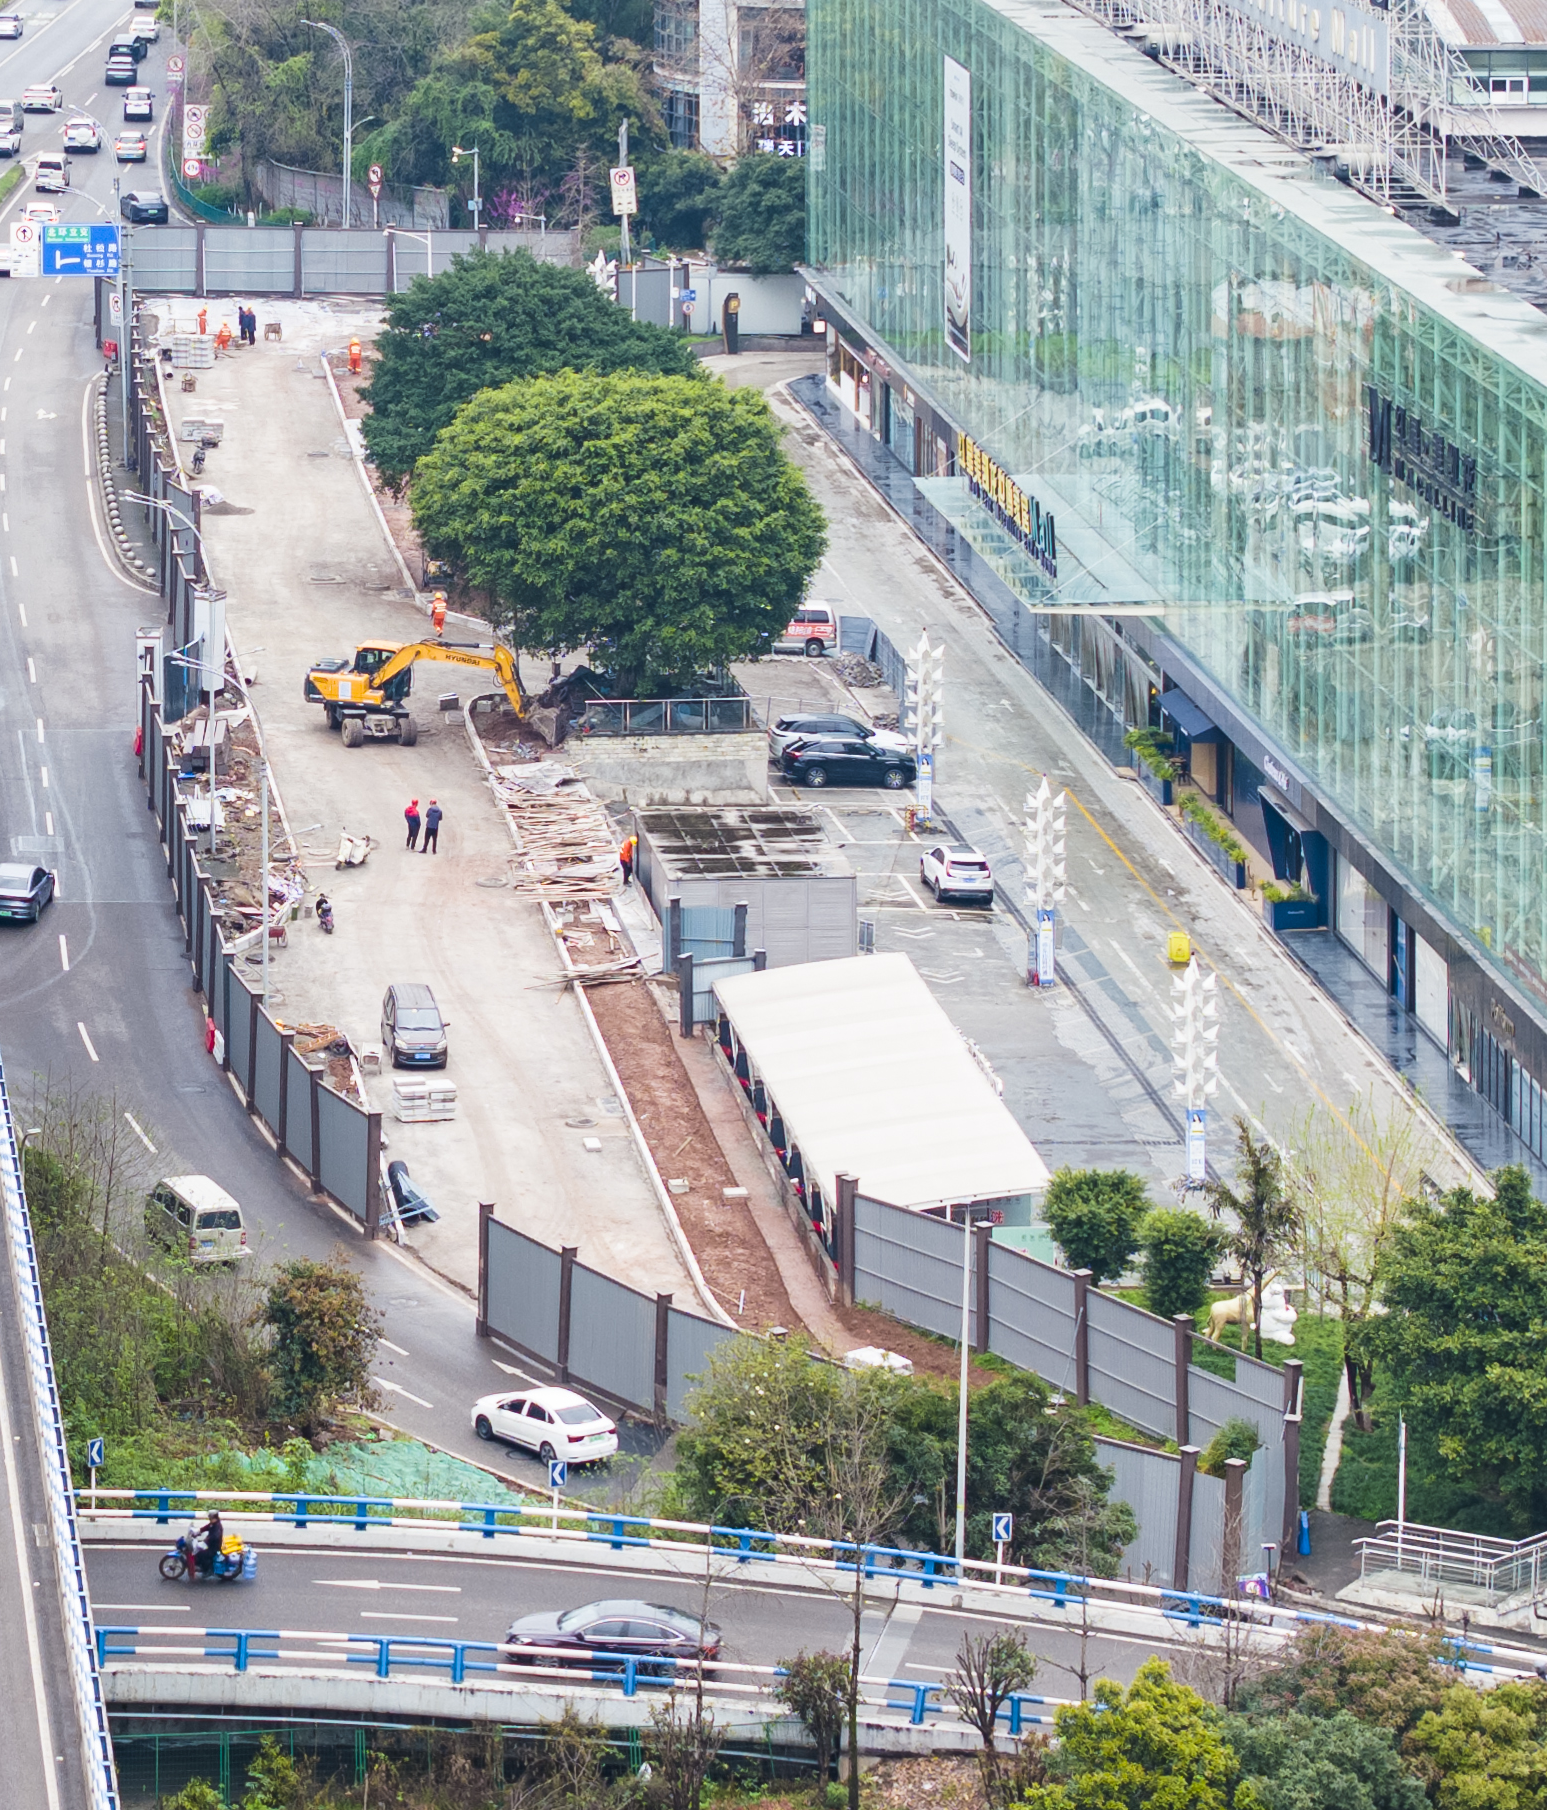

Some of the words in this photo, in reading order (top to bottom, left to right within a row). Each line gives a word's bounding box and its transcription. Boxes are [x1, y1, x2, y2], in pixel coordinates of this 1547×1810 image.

[1331, 7, 1375, 75] Mall
[48, 227, 89, 237] 北环立交
[731, 301, 739, 310] P
[445, 654, 480, 666] HYUNDAI
